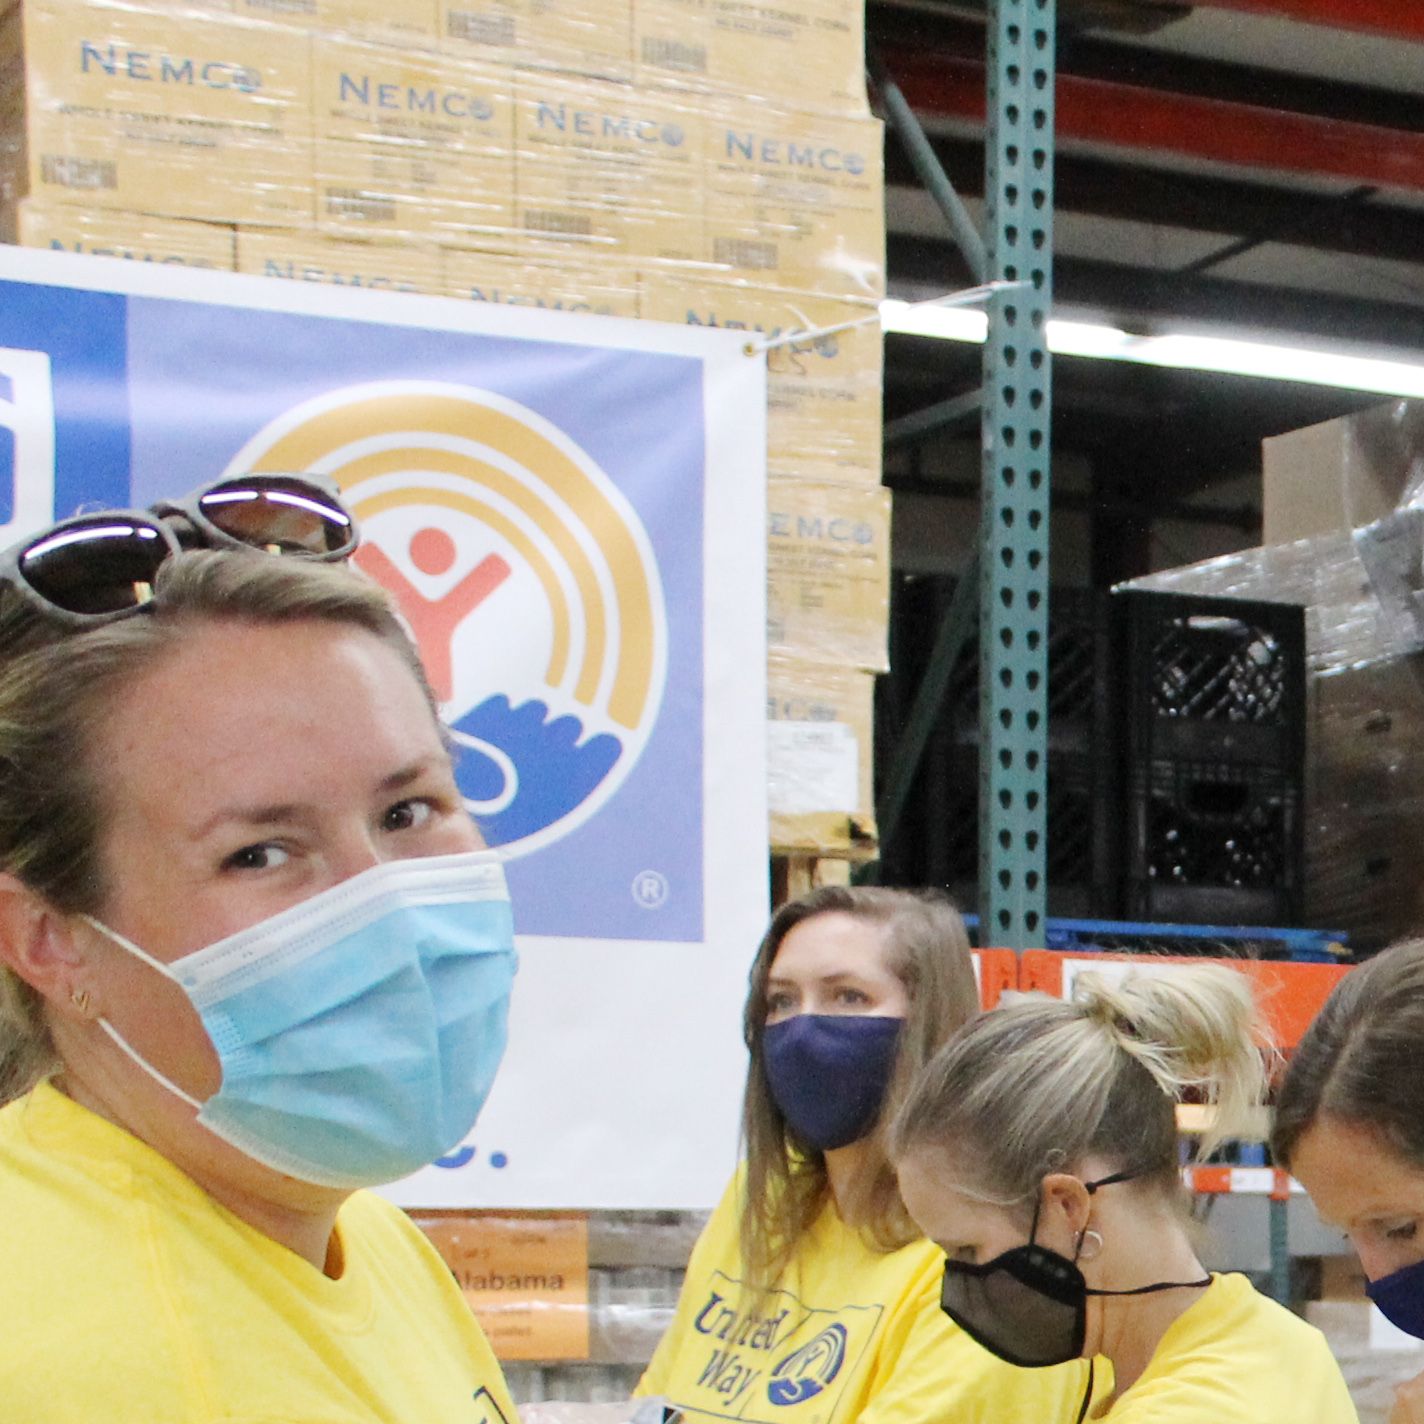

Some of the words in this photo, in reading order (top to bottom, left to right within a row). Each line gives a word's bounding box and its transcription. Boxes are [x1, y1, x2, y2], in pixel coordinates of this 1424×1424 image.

[338, 71, 494, 121] NEMCO
[725, 128, 866, 175] NEMCO
[696, 1349, 762, 1407] Way
